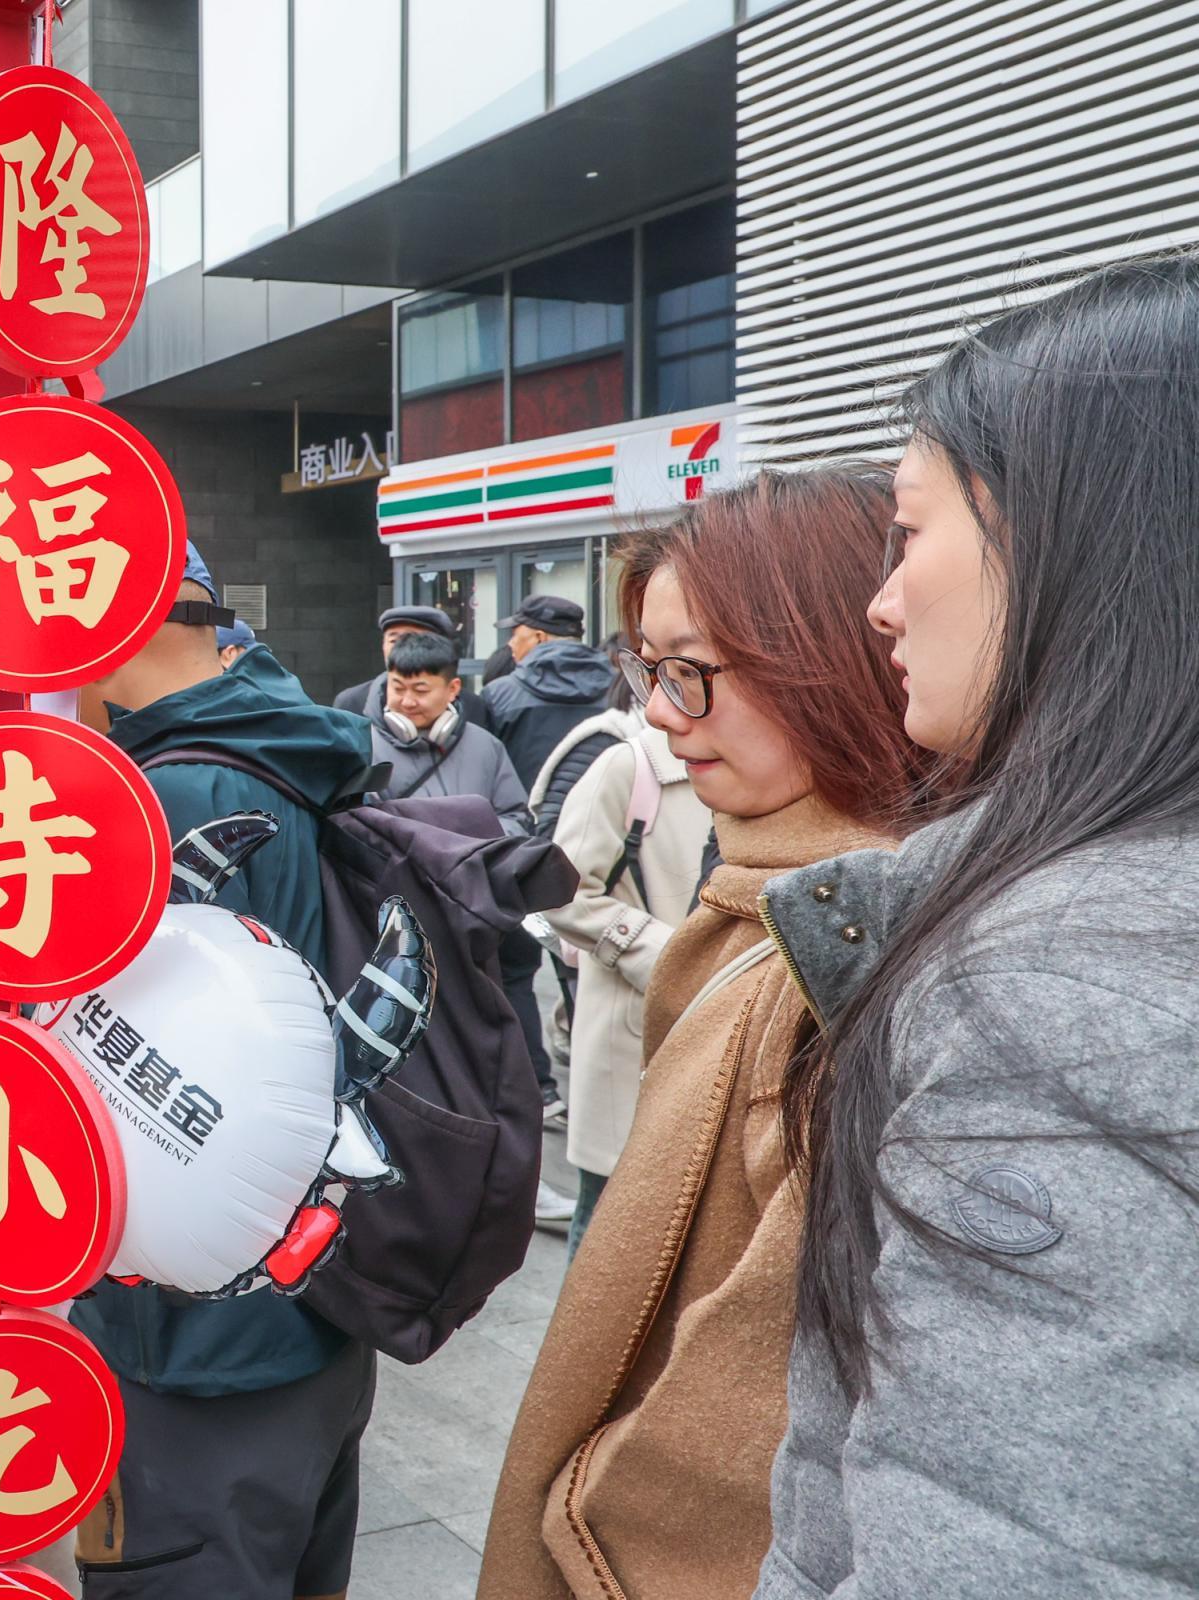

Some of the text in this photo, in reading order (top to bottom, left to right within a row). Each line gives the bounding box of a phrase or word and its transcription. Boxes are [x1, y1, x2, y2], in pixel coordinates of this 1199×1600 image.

[671, 421, 720, 501] 7
[72, 993, 224, 1147] 华夏基金
[105, 1092, 194, 1167] MANAGEMENT
